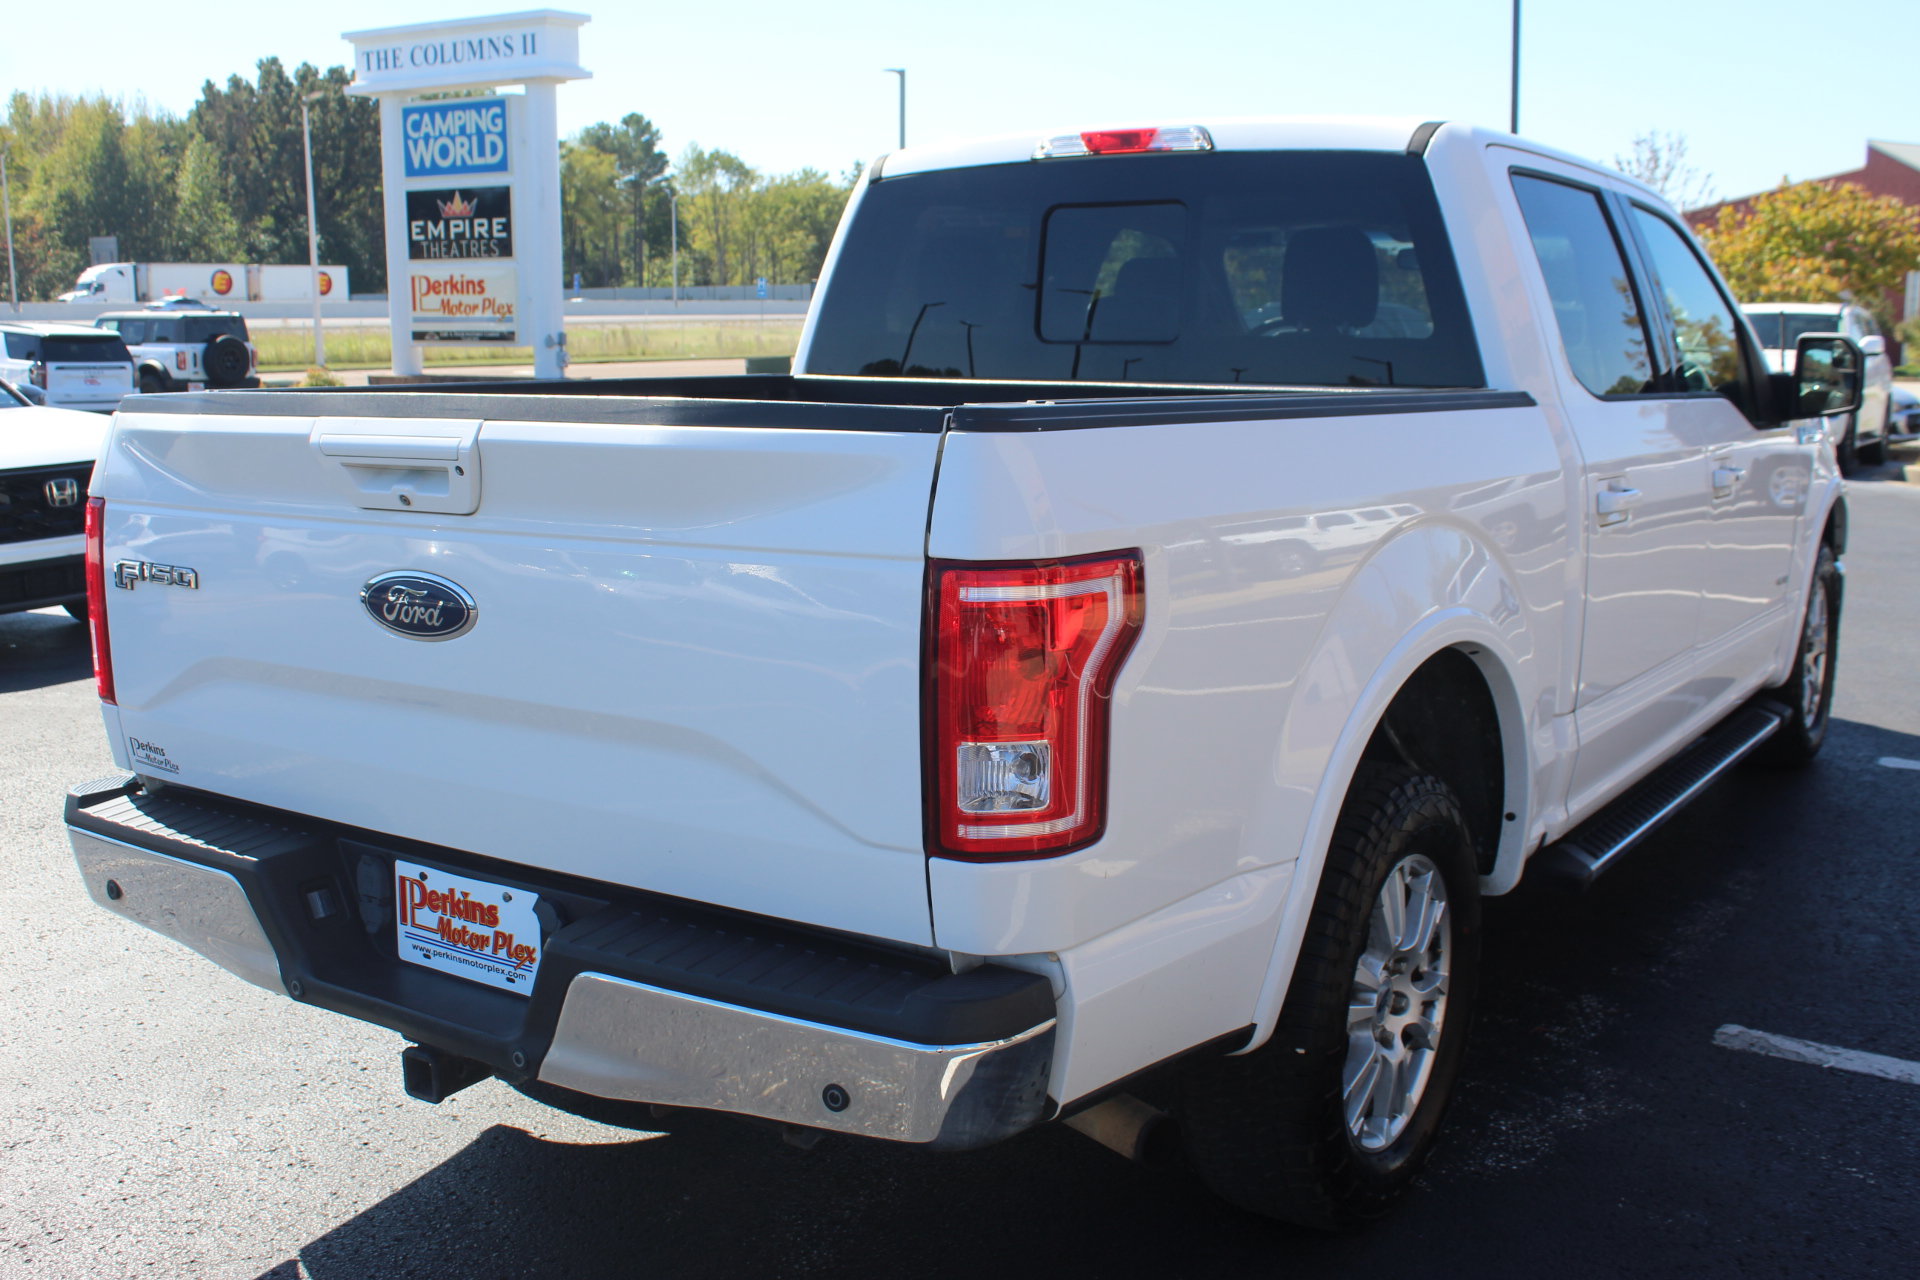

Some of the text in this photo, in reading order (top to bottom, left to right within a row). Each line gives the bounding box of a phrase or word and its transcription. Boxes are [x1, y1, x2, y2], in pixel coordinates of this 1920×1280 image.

[362, 33, 538, 72] THE COLUMNS II
[406, 106, 503, 139] CAMPING
[407, 134, 504, 169] WORLD
[410, 217, 508, 241] EMPIRE
[420, 239, 500, 258] THEATRES
[411, 274, 486, 312] Perkins
[440, 297, 514, 322] Motor Plex
[383, 585, 444, 627] Ford
[129, 736, 166, 756] Perkins
[399, 875, 500, 928] Perkins
[437, 916, 537, 970] Motor Plex
[412, 943, 527, 981] www.perkinsmotorplex.com
